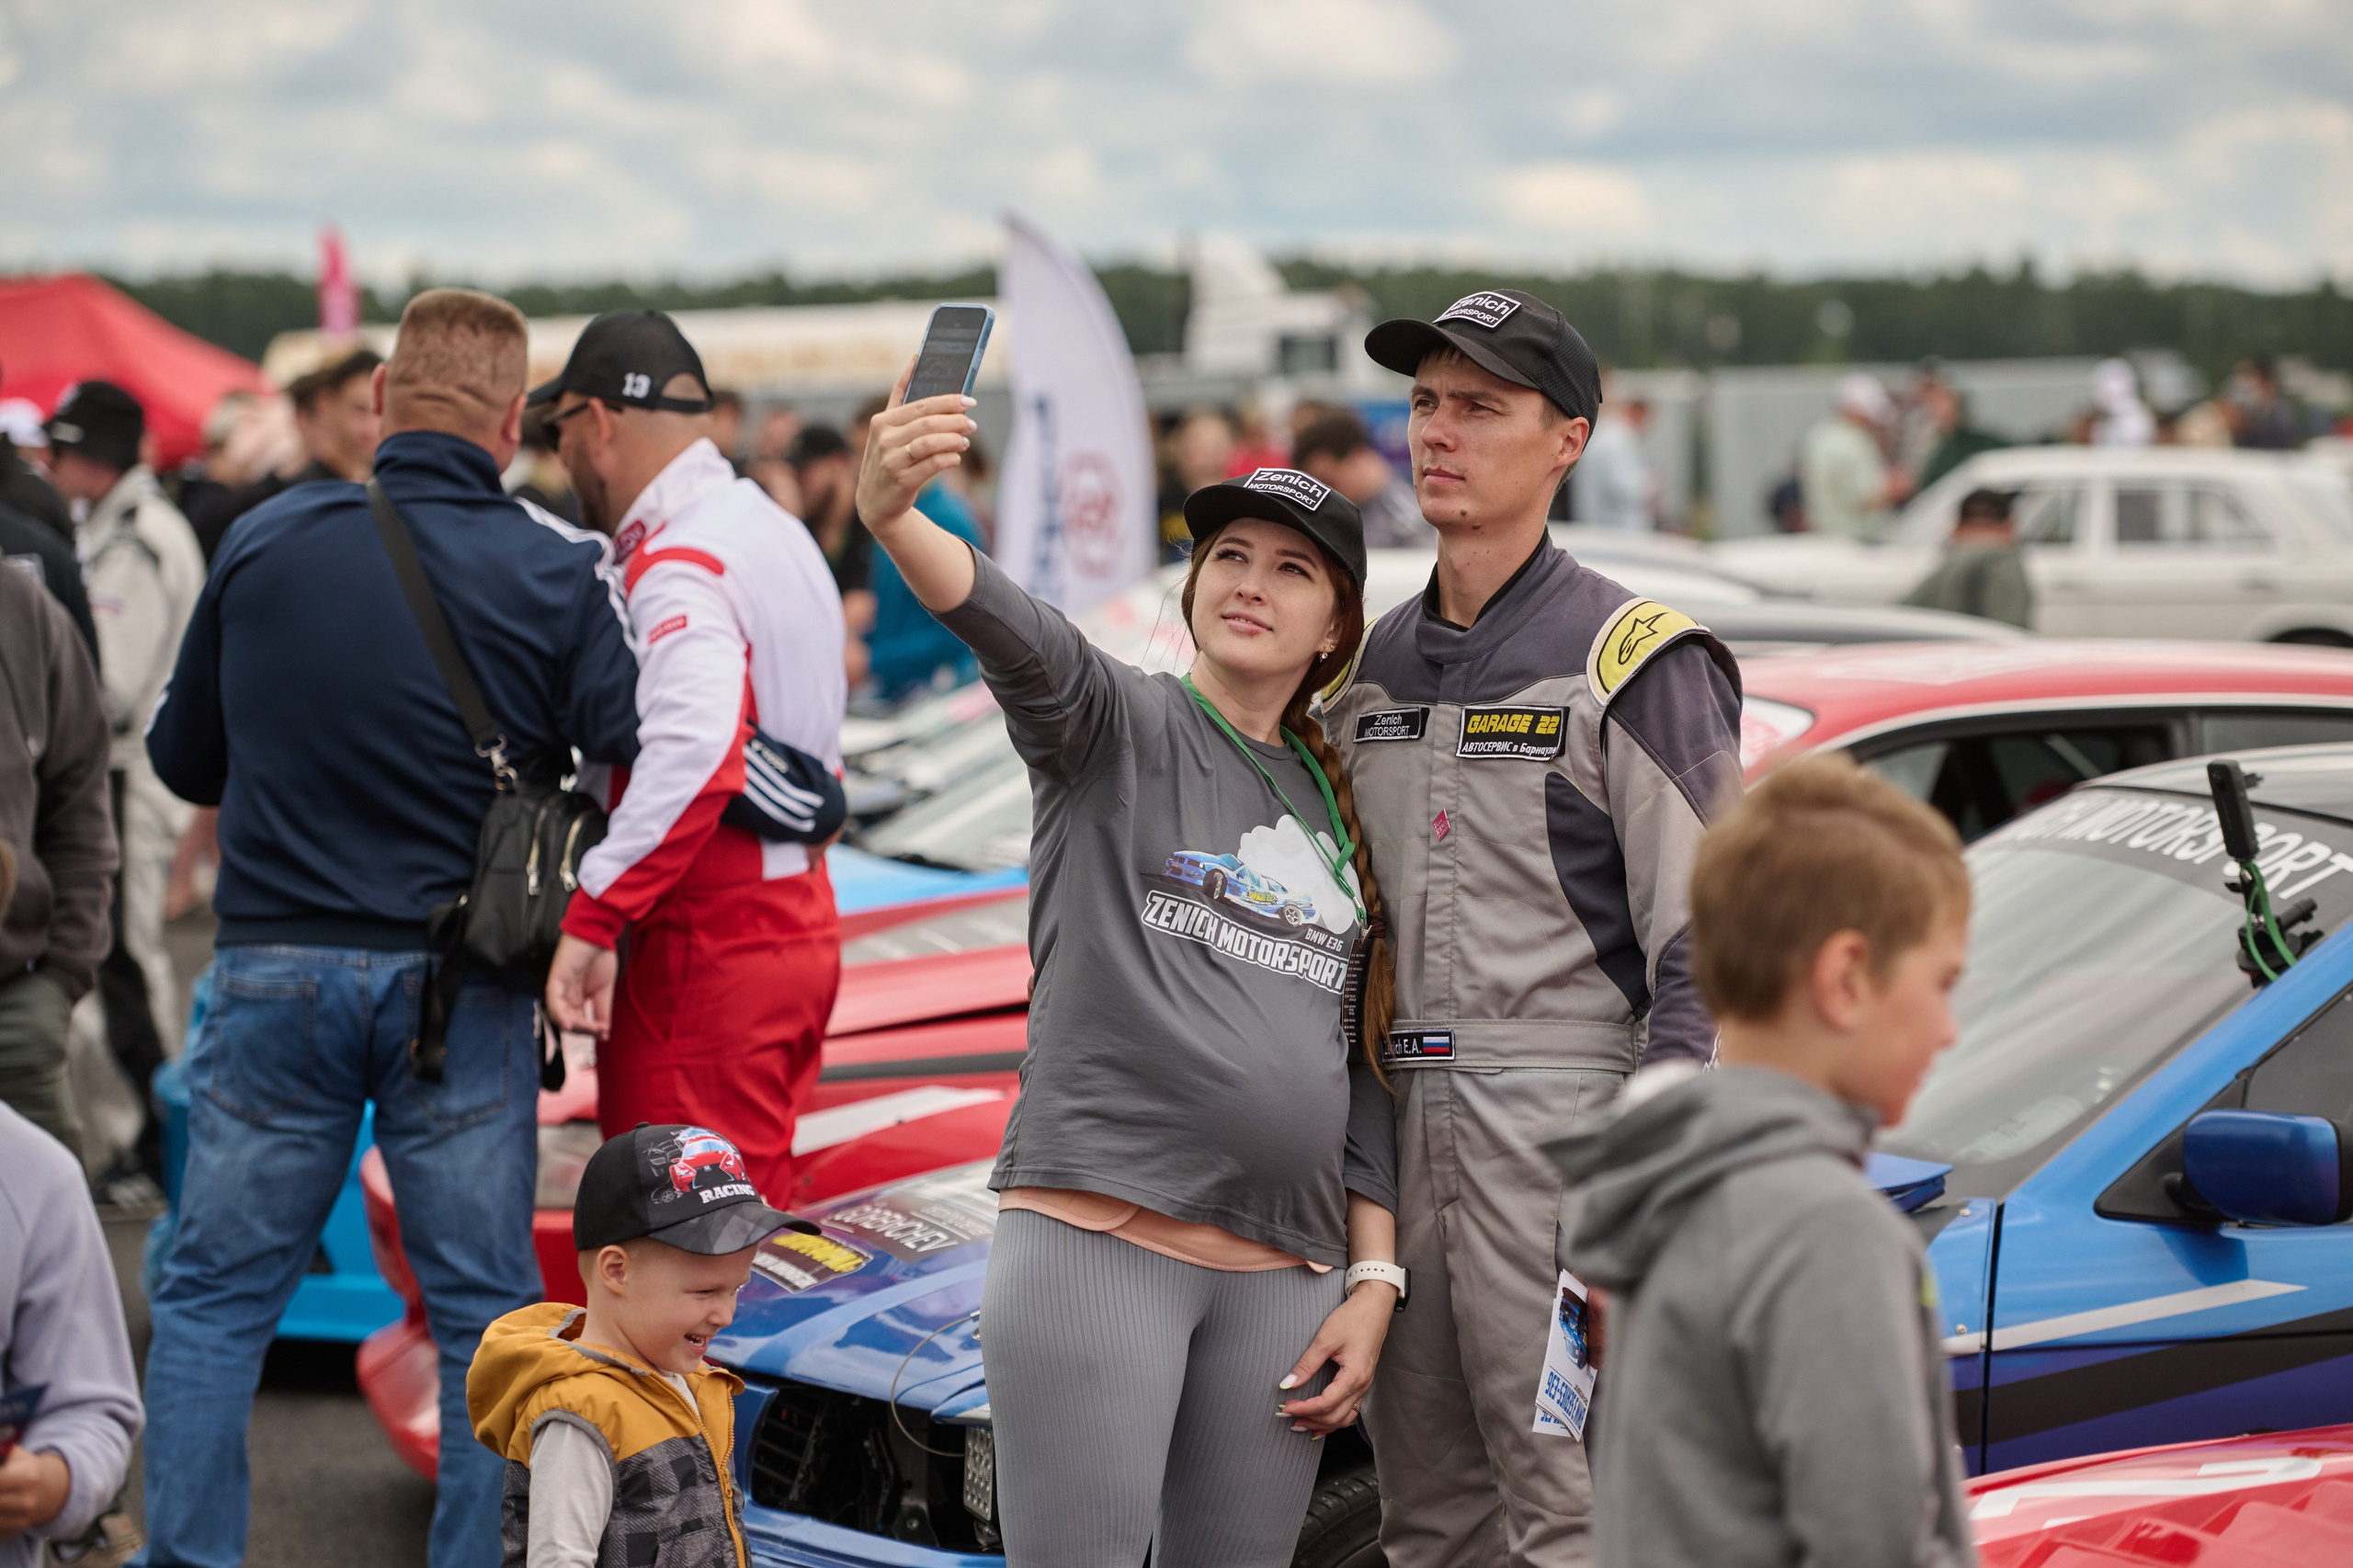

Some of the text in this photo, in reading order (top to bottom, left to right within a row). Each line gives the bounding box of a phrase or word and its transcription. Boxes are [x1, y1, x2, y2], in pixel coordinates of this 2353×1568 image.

[621, 371, 652, 399] 13
[1247, 483, 1316, 506] MOTORSPORT
[1254, 472, 1323, 498] Zenich
[1374, 713, 1403, 726] Zenich
[1466, 714, 1561, 734] GARAGE 22
[1364, 725, 1410, 737] MOTORSPORT
[1461, 741, 1514, 753] АВТОСЕРВИС
[1512, 744, 1519, 753] в
[1144, 895, 1348, 990] ZENICH MOTORSPORT
[1305, 927, 1344, 952] BMW E36
[699, 1183, 756, 1204] RACING
